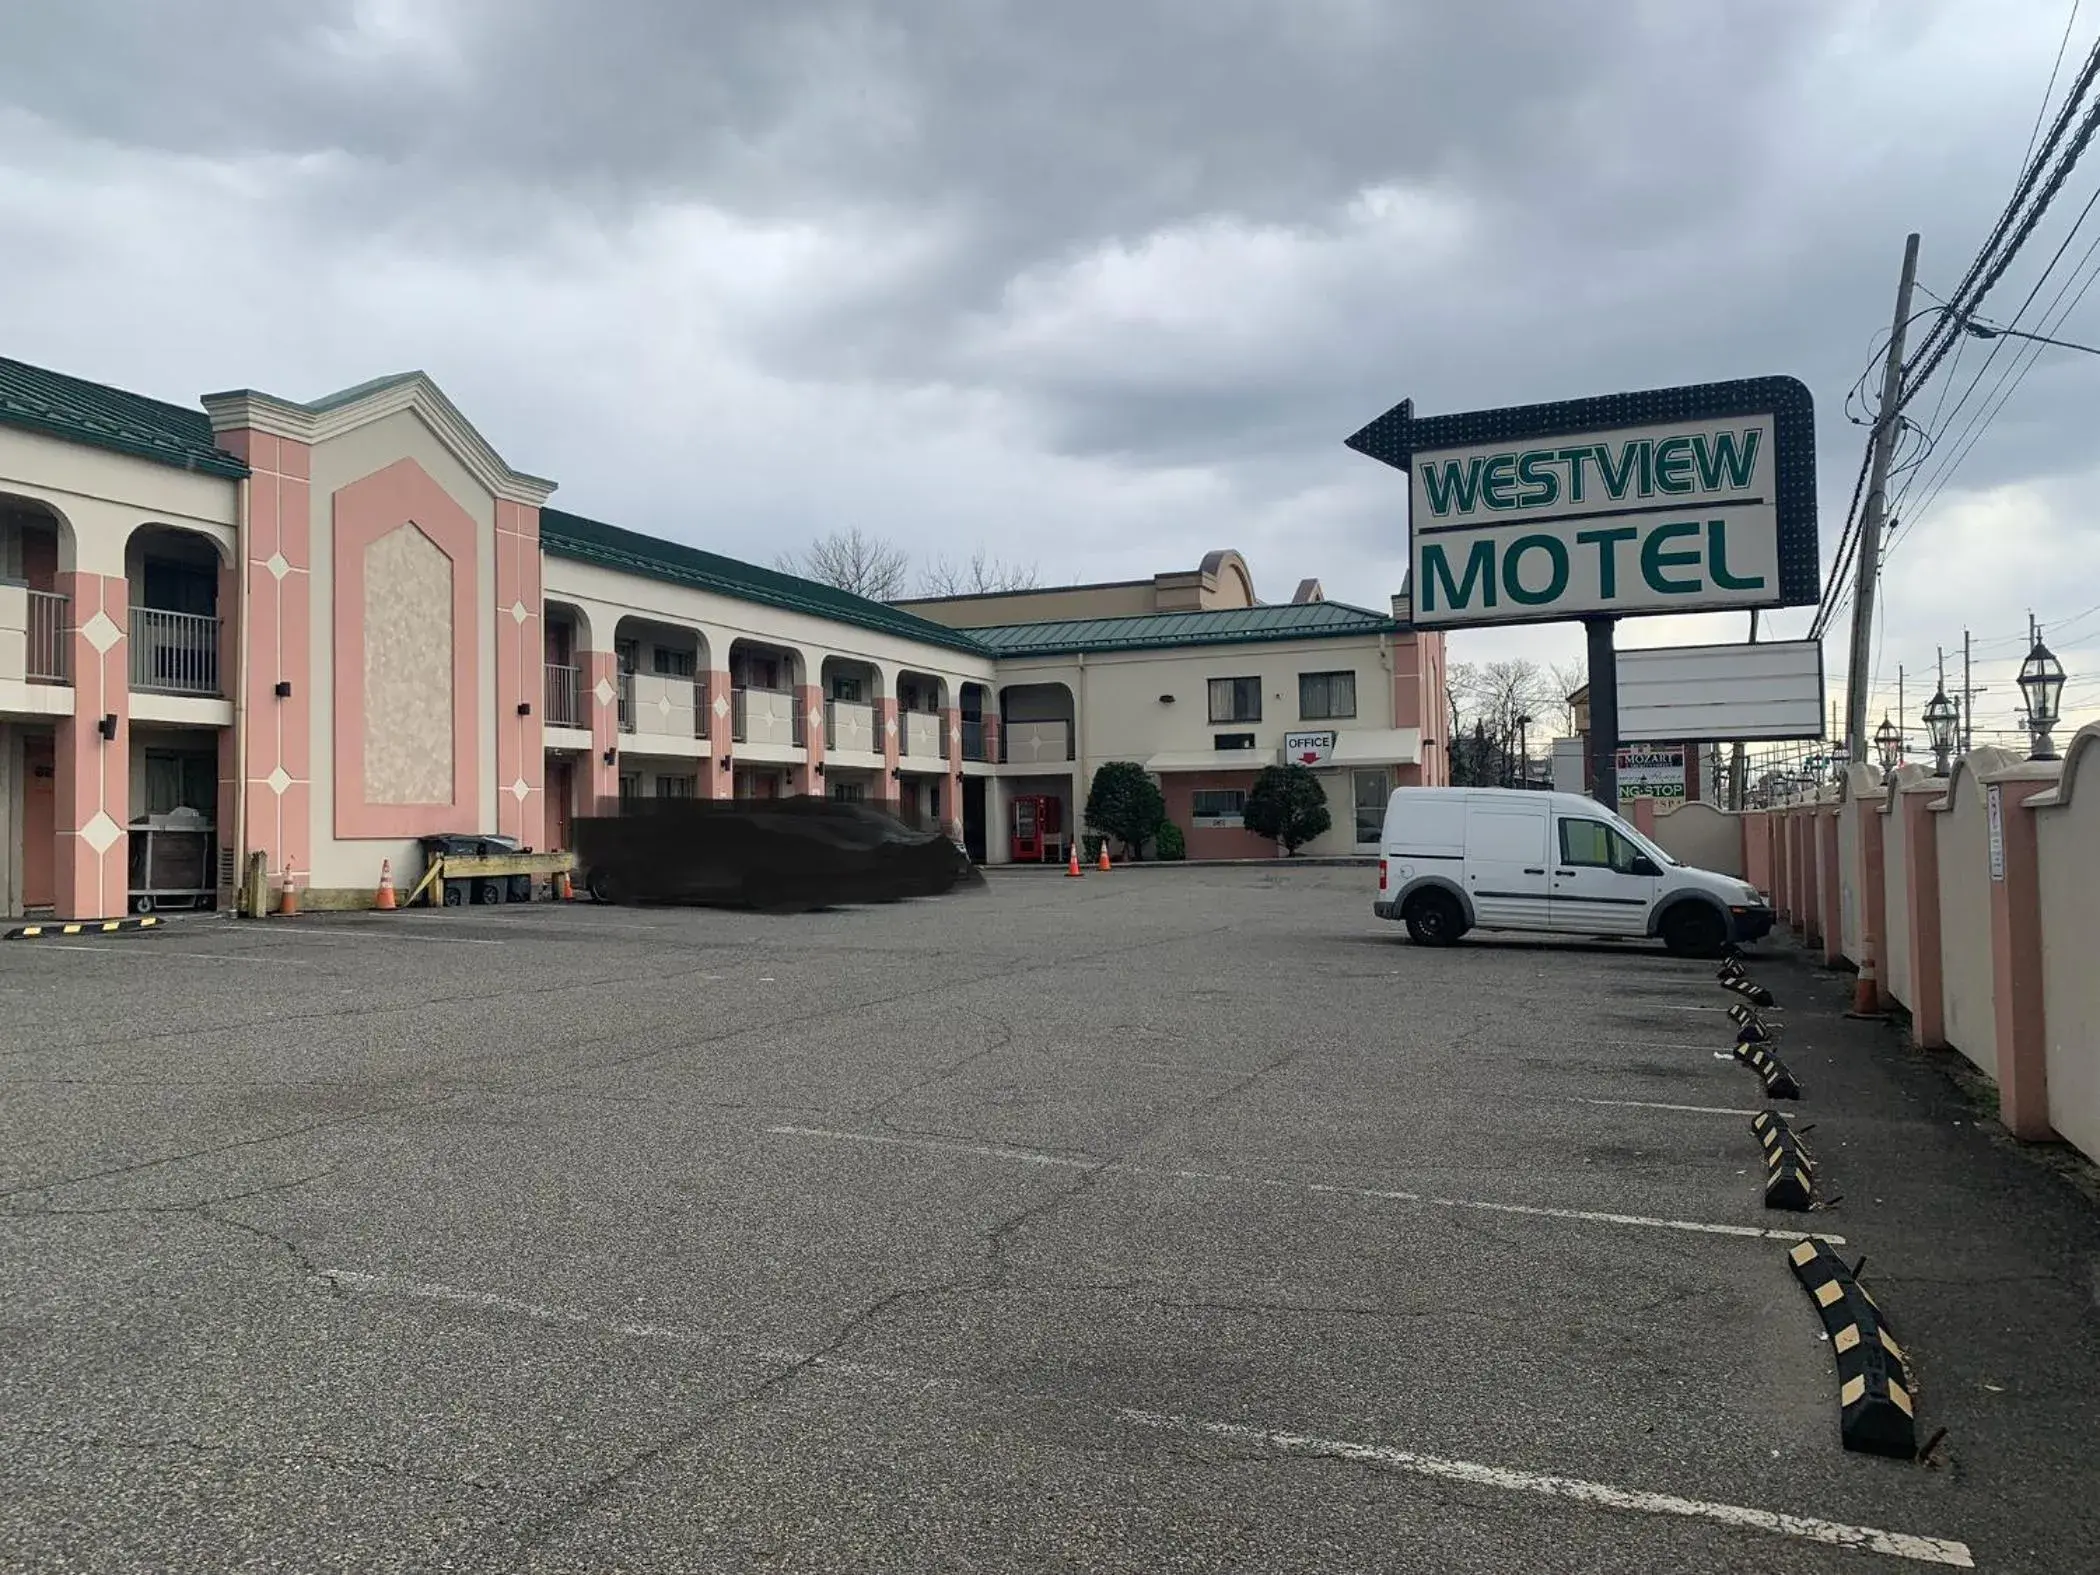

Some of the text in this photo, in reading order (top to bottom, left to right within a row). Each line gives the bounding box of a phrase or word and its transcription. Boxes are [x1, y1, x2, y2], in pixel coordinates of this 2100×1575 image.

[1418, 428, 1763, 517] WESTVIEW
[1421, 520, 1765, 612] MOTEL
[1288, 737, 1330, 749] OFFICE
